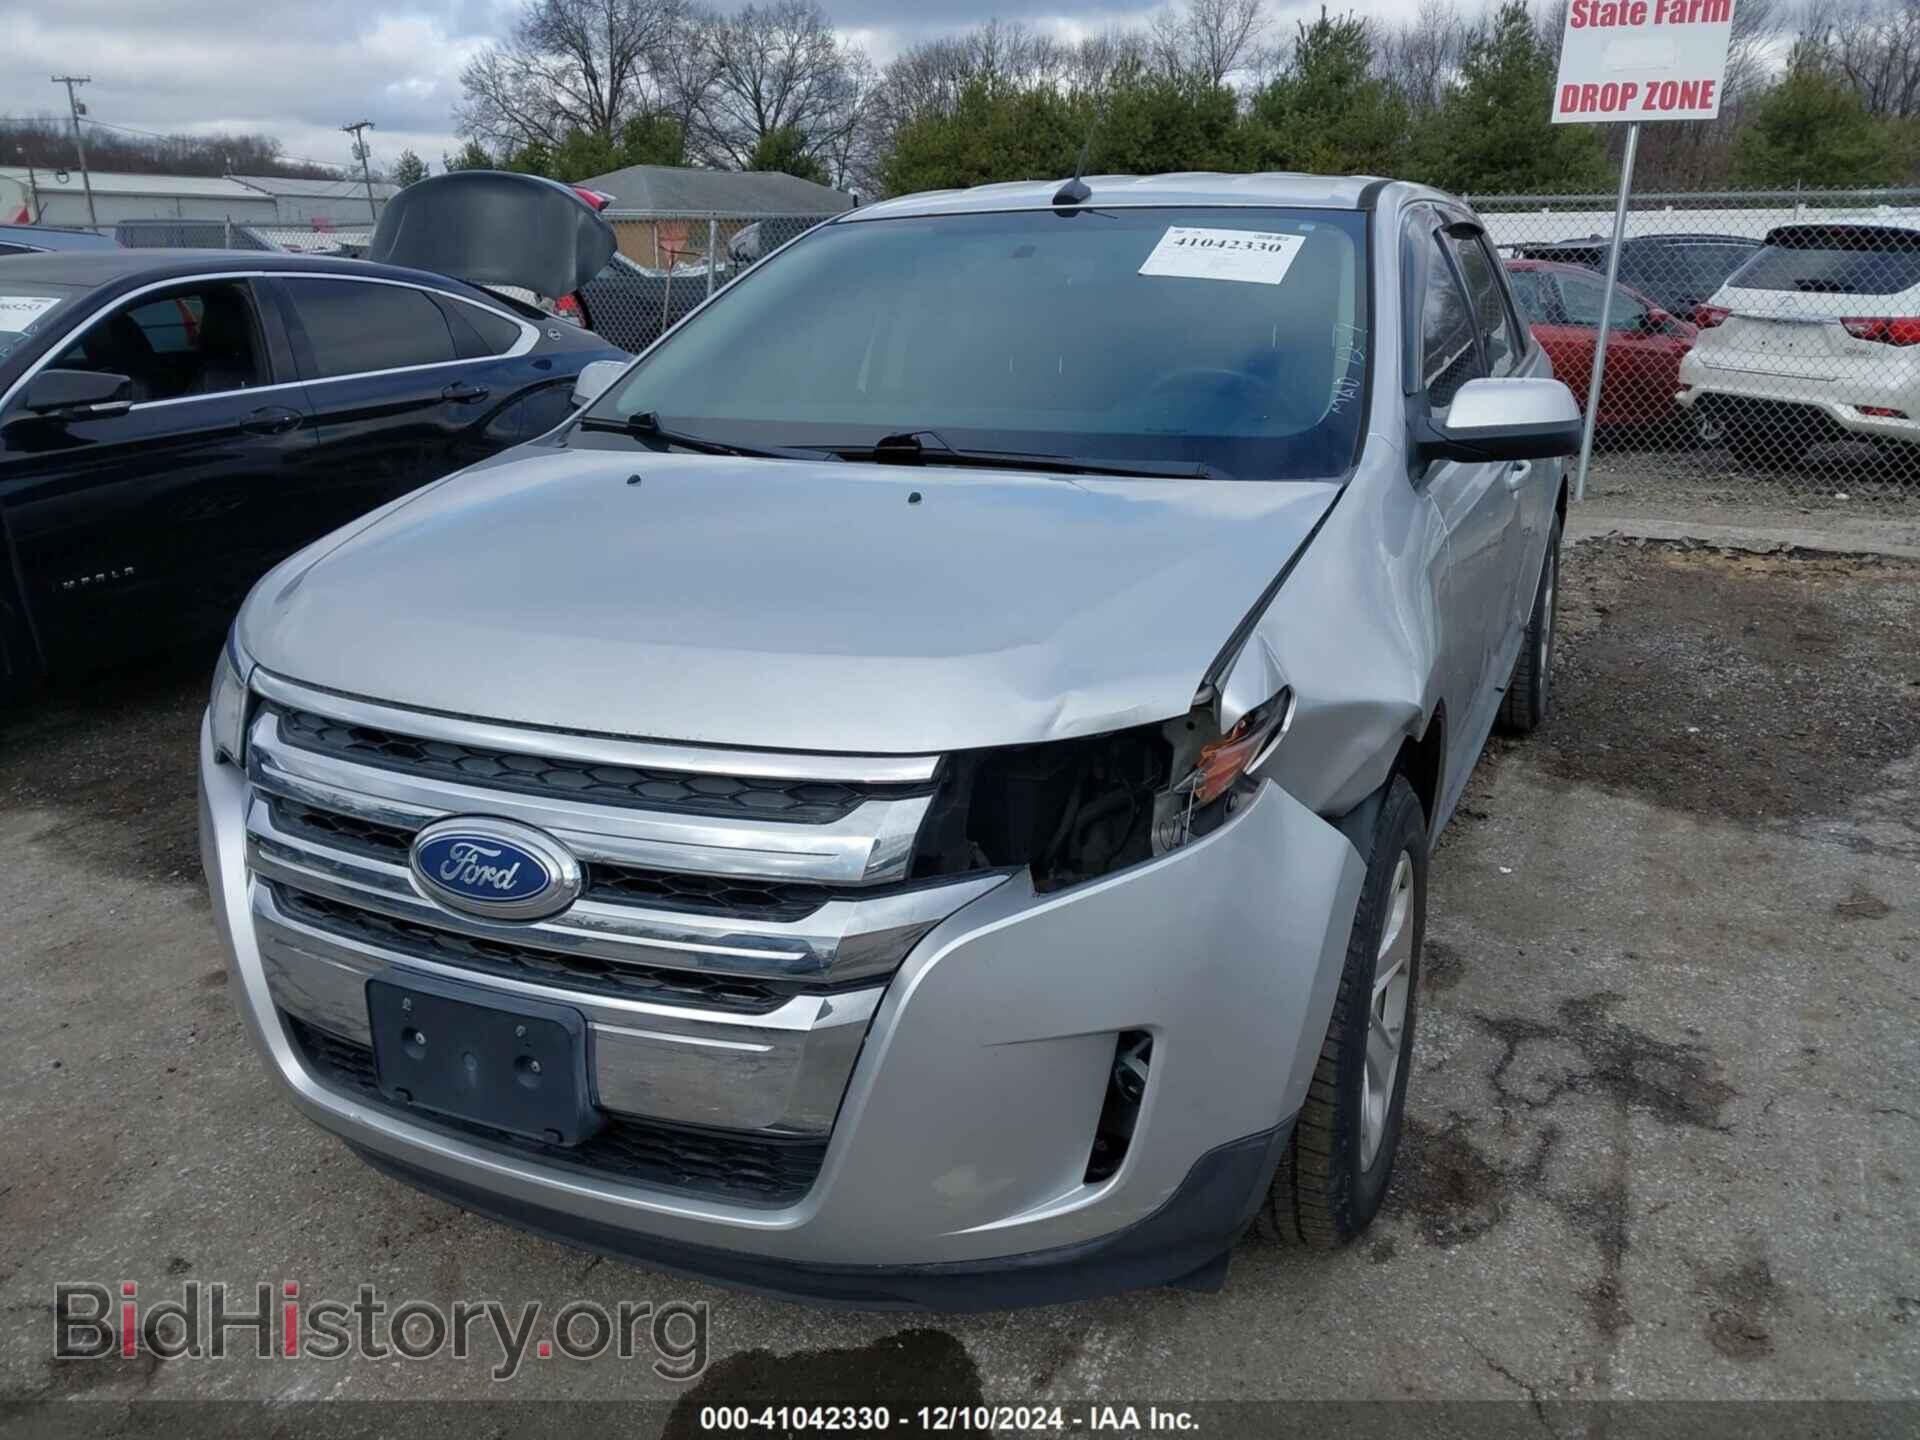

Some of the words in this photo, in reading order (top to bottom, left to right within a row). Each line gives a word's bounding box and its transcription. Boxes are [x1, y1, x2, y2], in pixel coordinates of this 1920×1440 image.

[1570, 0, 1648, 29] State
[1654, 0, 1732, 25] Farm
[1559, 82, 1639, 114] DROP
[1642, 79, 1717, 111] ZONE
[1174, 236, 1283, 253] 41042330
[439, 842, 521, 890] Ford
